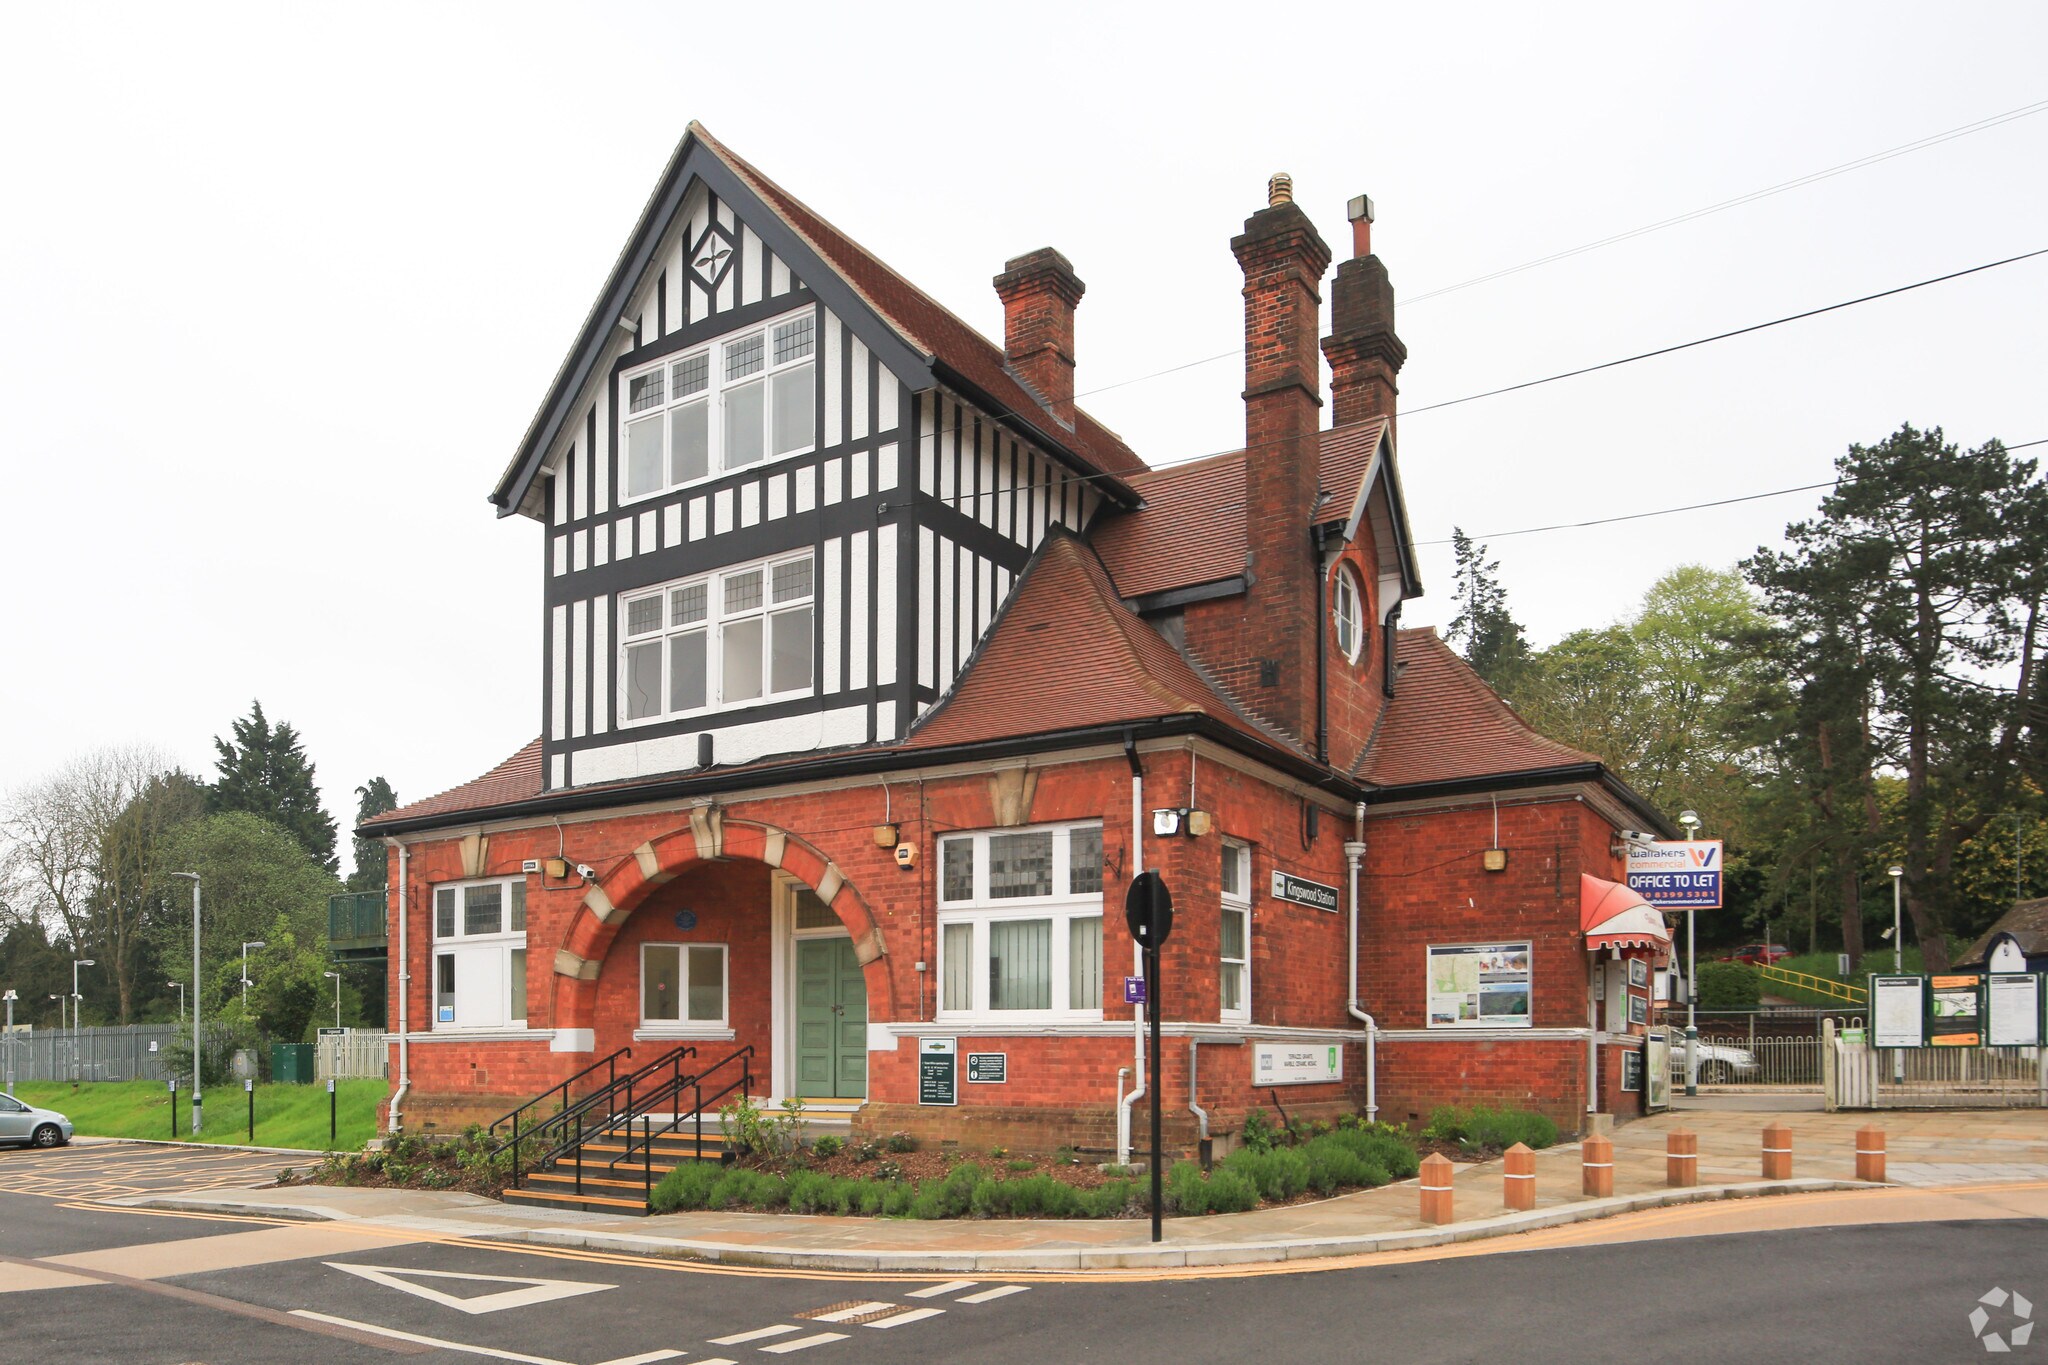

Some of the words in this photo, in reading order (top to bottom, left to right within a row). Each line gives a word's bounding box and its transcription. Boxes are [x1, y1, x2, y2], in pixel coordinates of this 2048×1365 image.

[1630, 850, 1686, 858] wallakers
[1630, 860, 1686, 869] commercial
[1629, 875, 1671, 888] OFFICE
[1673, 875, 1690, 887] TO
[1693, 875, 1715, 887] LET
[1287, 881, 1316, 901] Kingswood
[1317, 889, 1336, 906] Station
